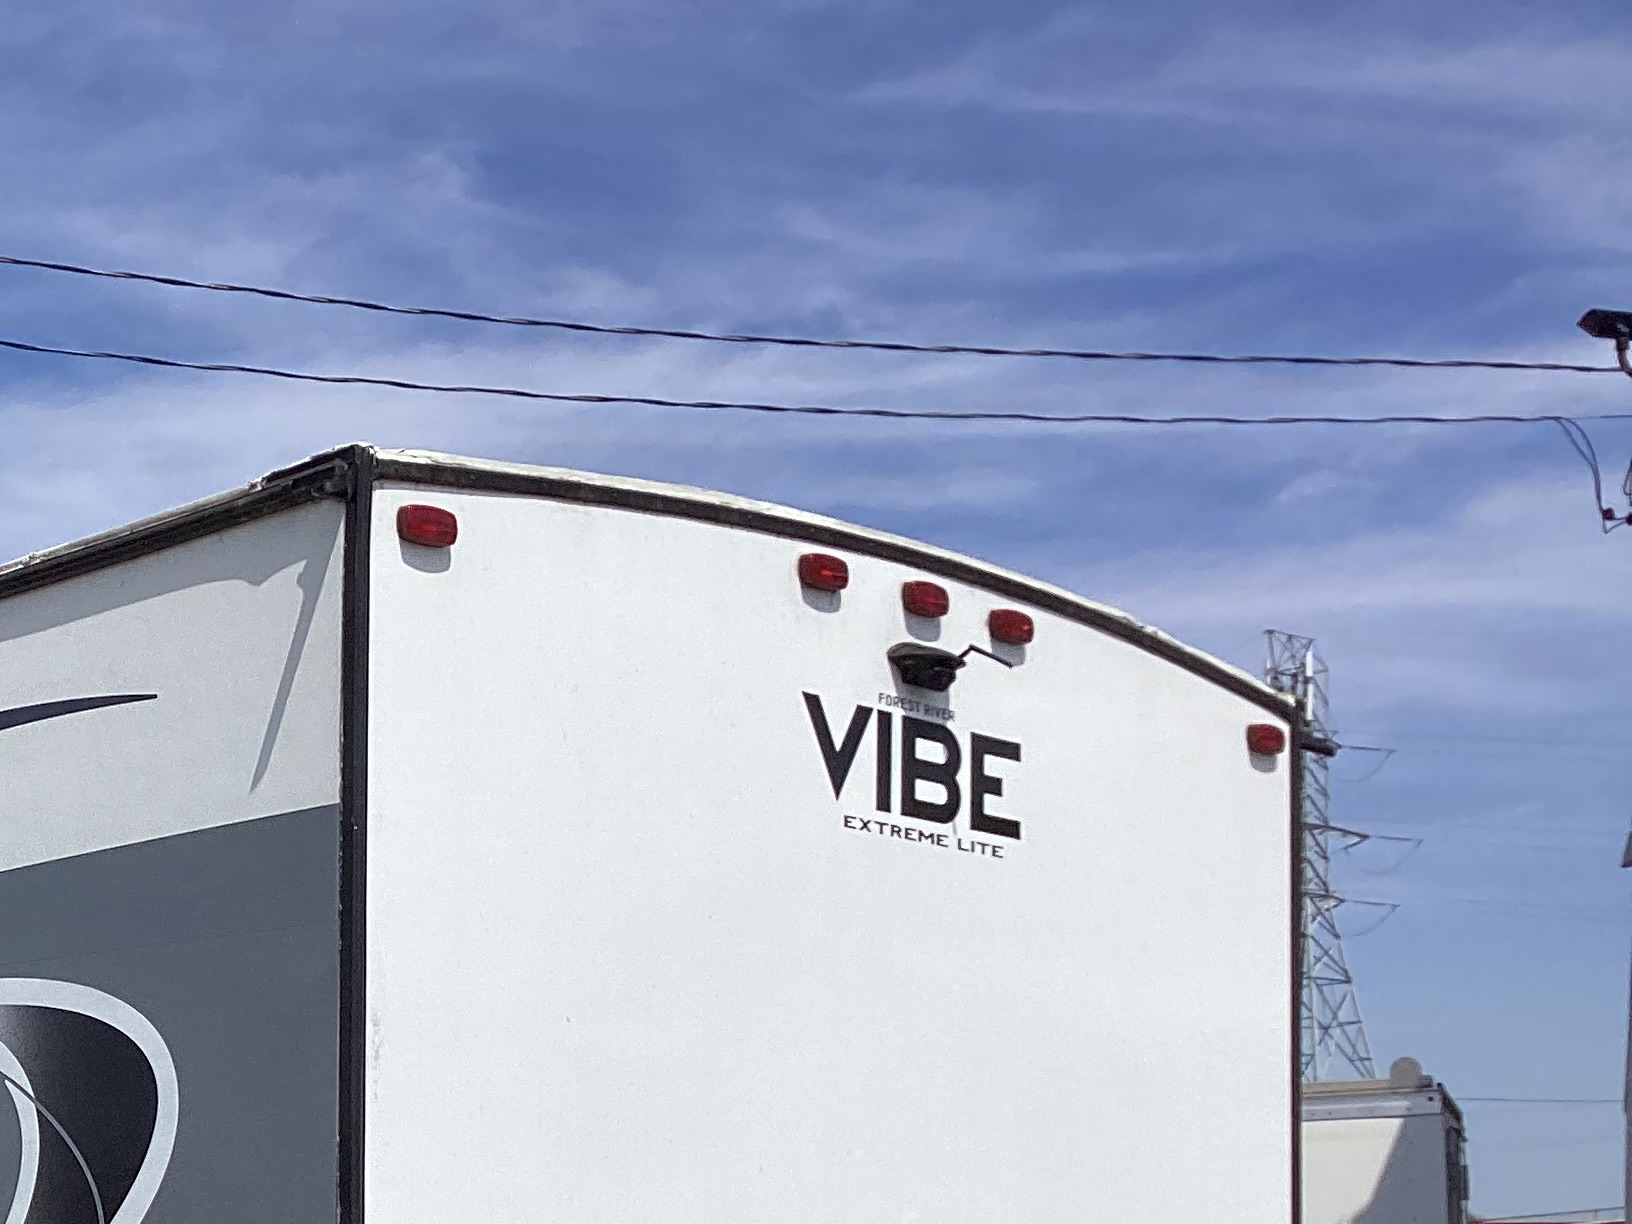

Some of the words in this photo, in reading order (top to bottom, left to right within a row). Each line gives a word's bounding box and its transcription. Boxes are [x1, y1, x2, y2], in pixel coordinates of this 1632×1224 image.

[878, 692, 922, 713] FOREST
[924, 703, 955, 722] RIVER
[802, 691, 1022, 840] VIBE
[843, 814, 950, 848] EXTREME
[957, 838, 1004, 859] LITE
